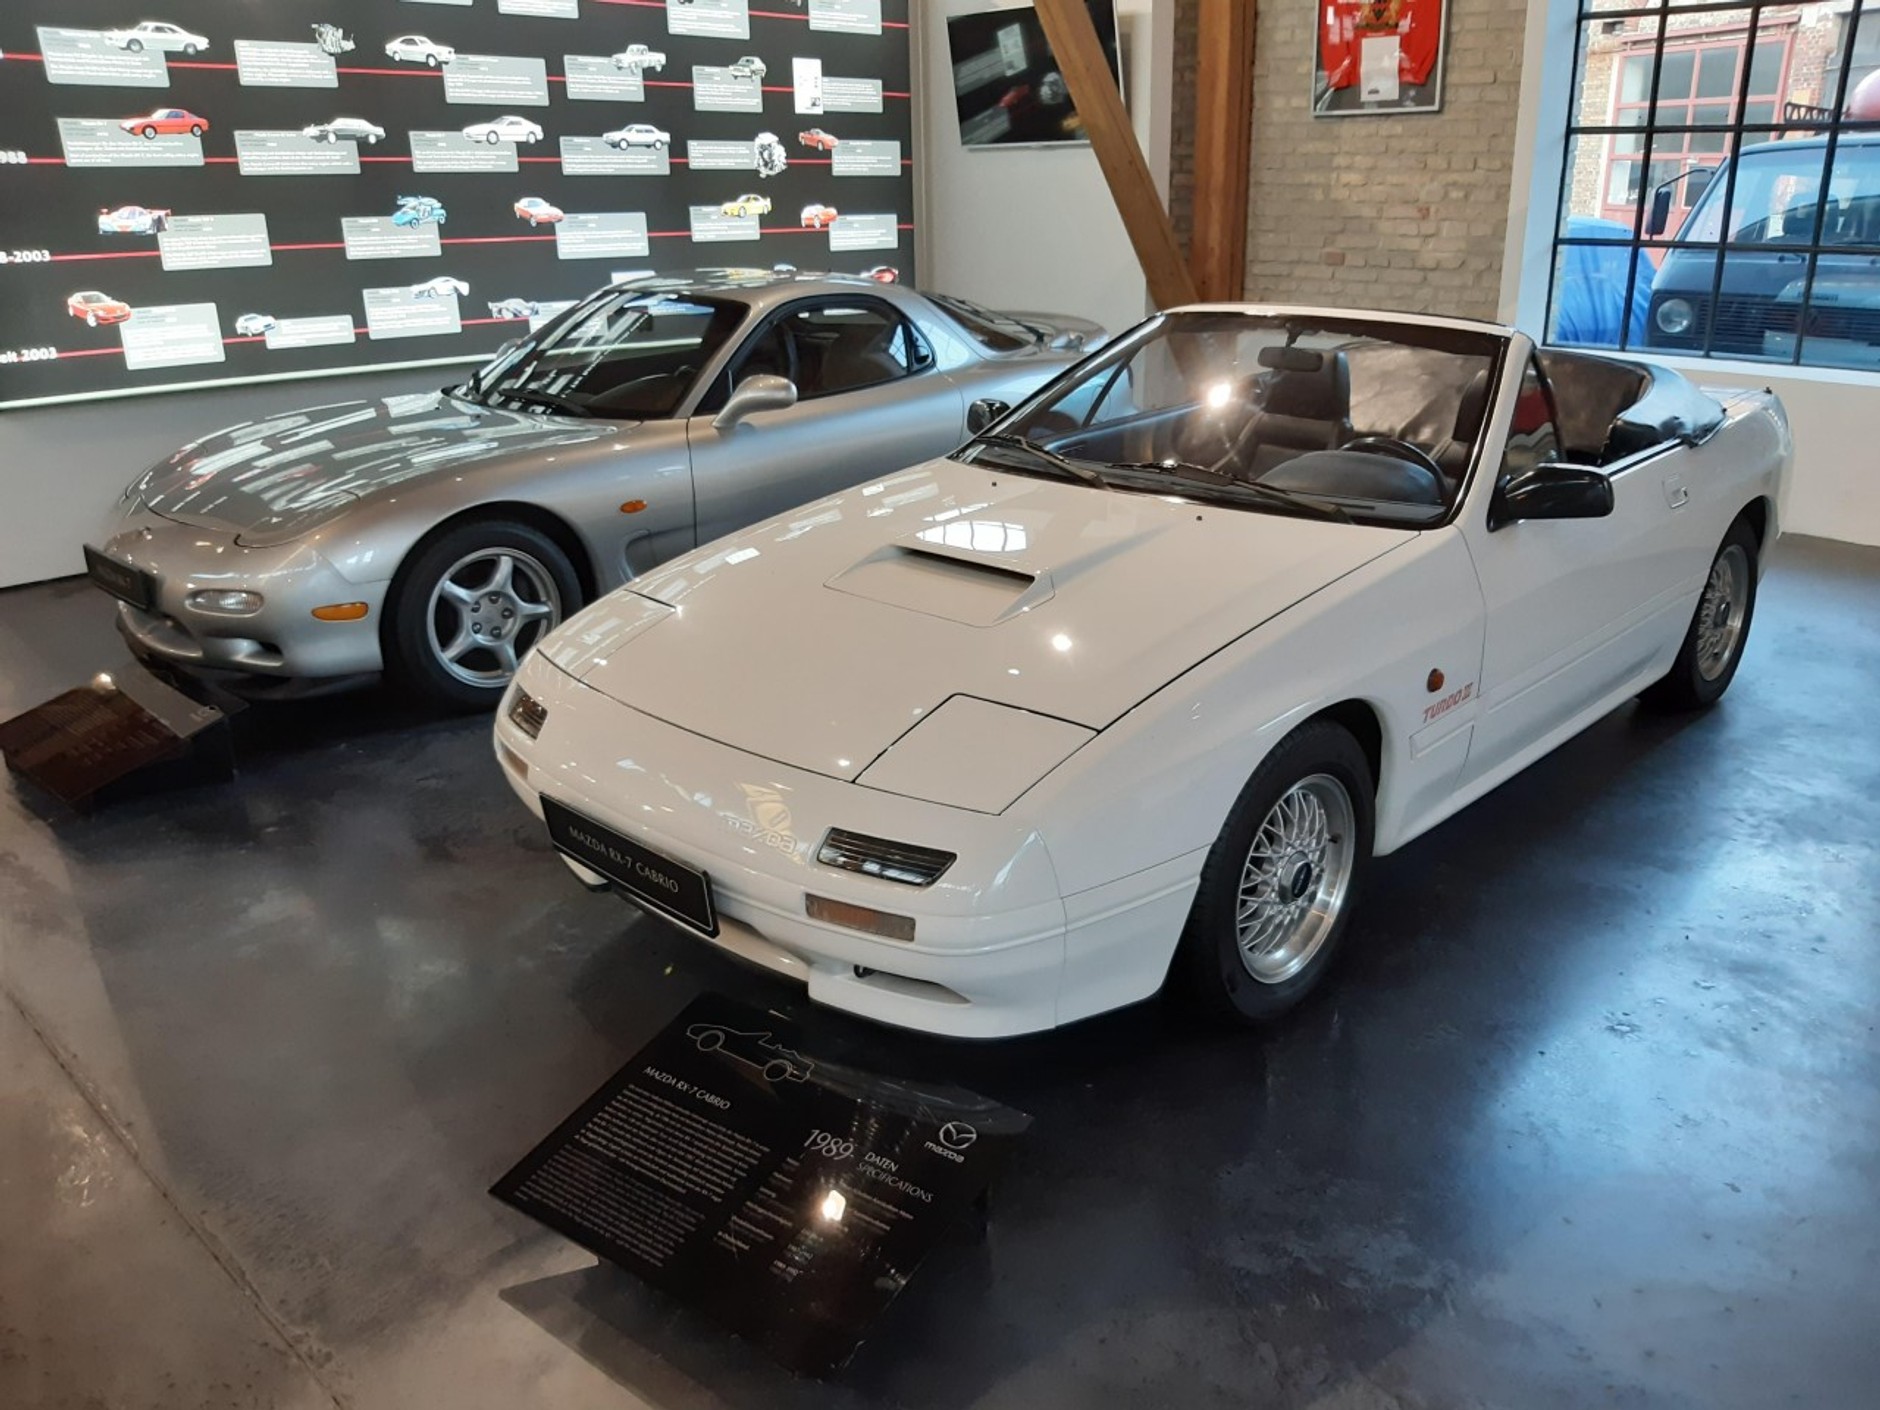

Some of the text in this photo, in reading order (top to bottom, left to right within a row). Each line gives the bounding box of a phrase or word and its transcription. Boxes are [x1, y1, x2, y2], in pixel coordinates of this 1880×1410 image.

[21, 346, 58, 362] 2003
[1423, 688, 1463, 723] TURBO
[569, 825, 679, 893] MAZDA RX-7 CABRIO
[643, 1066, 731, 1110] MAZDA RX-7 CABRIO
[803, 1129, 854, 1161] 1989
[864, 1151, 899, 1172] DATEN
[923, 1140, 965, 1163] mazda
[856, 1161, 934, 1203] SPECIFICATIONS
